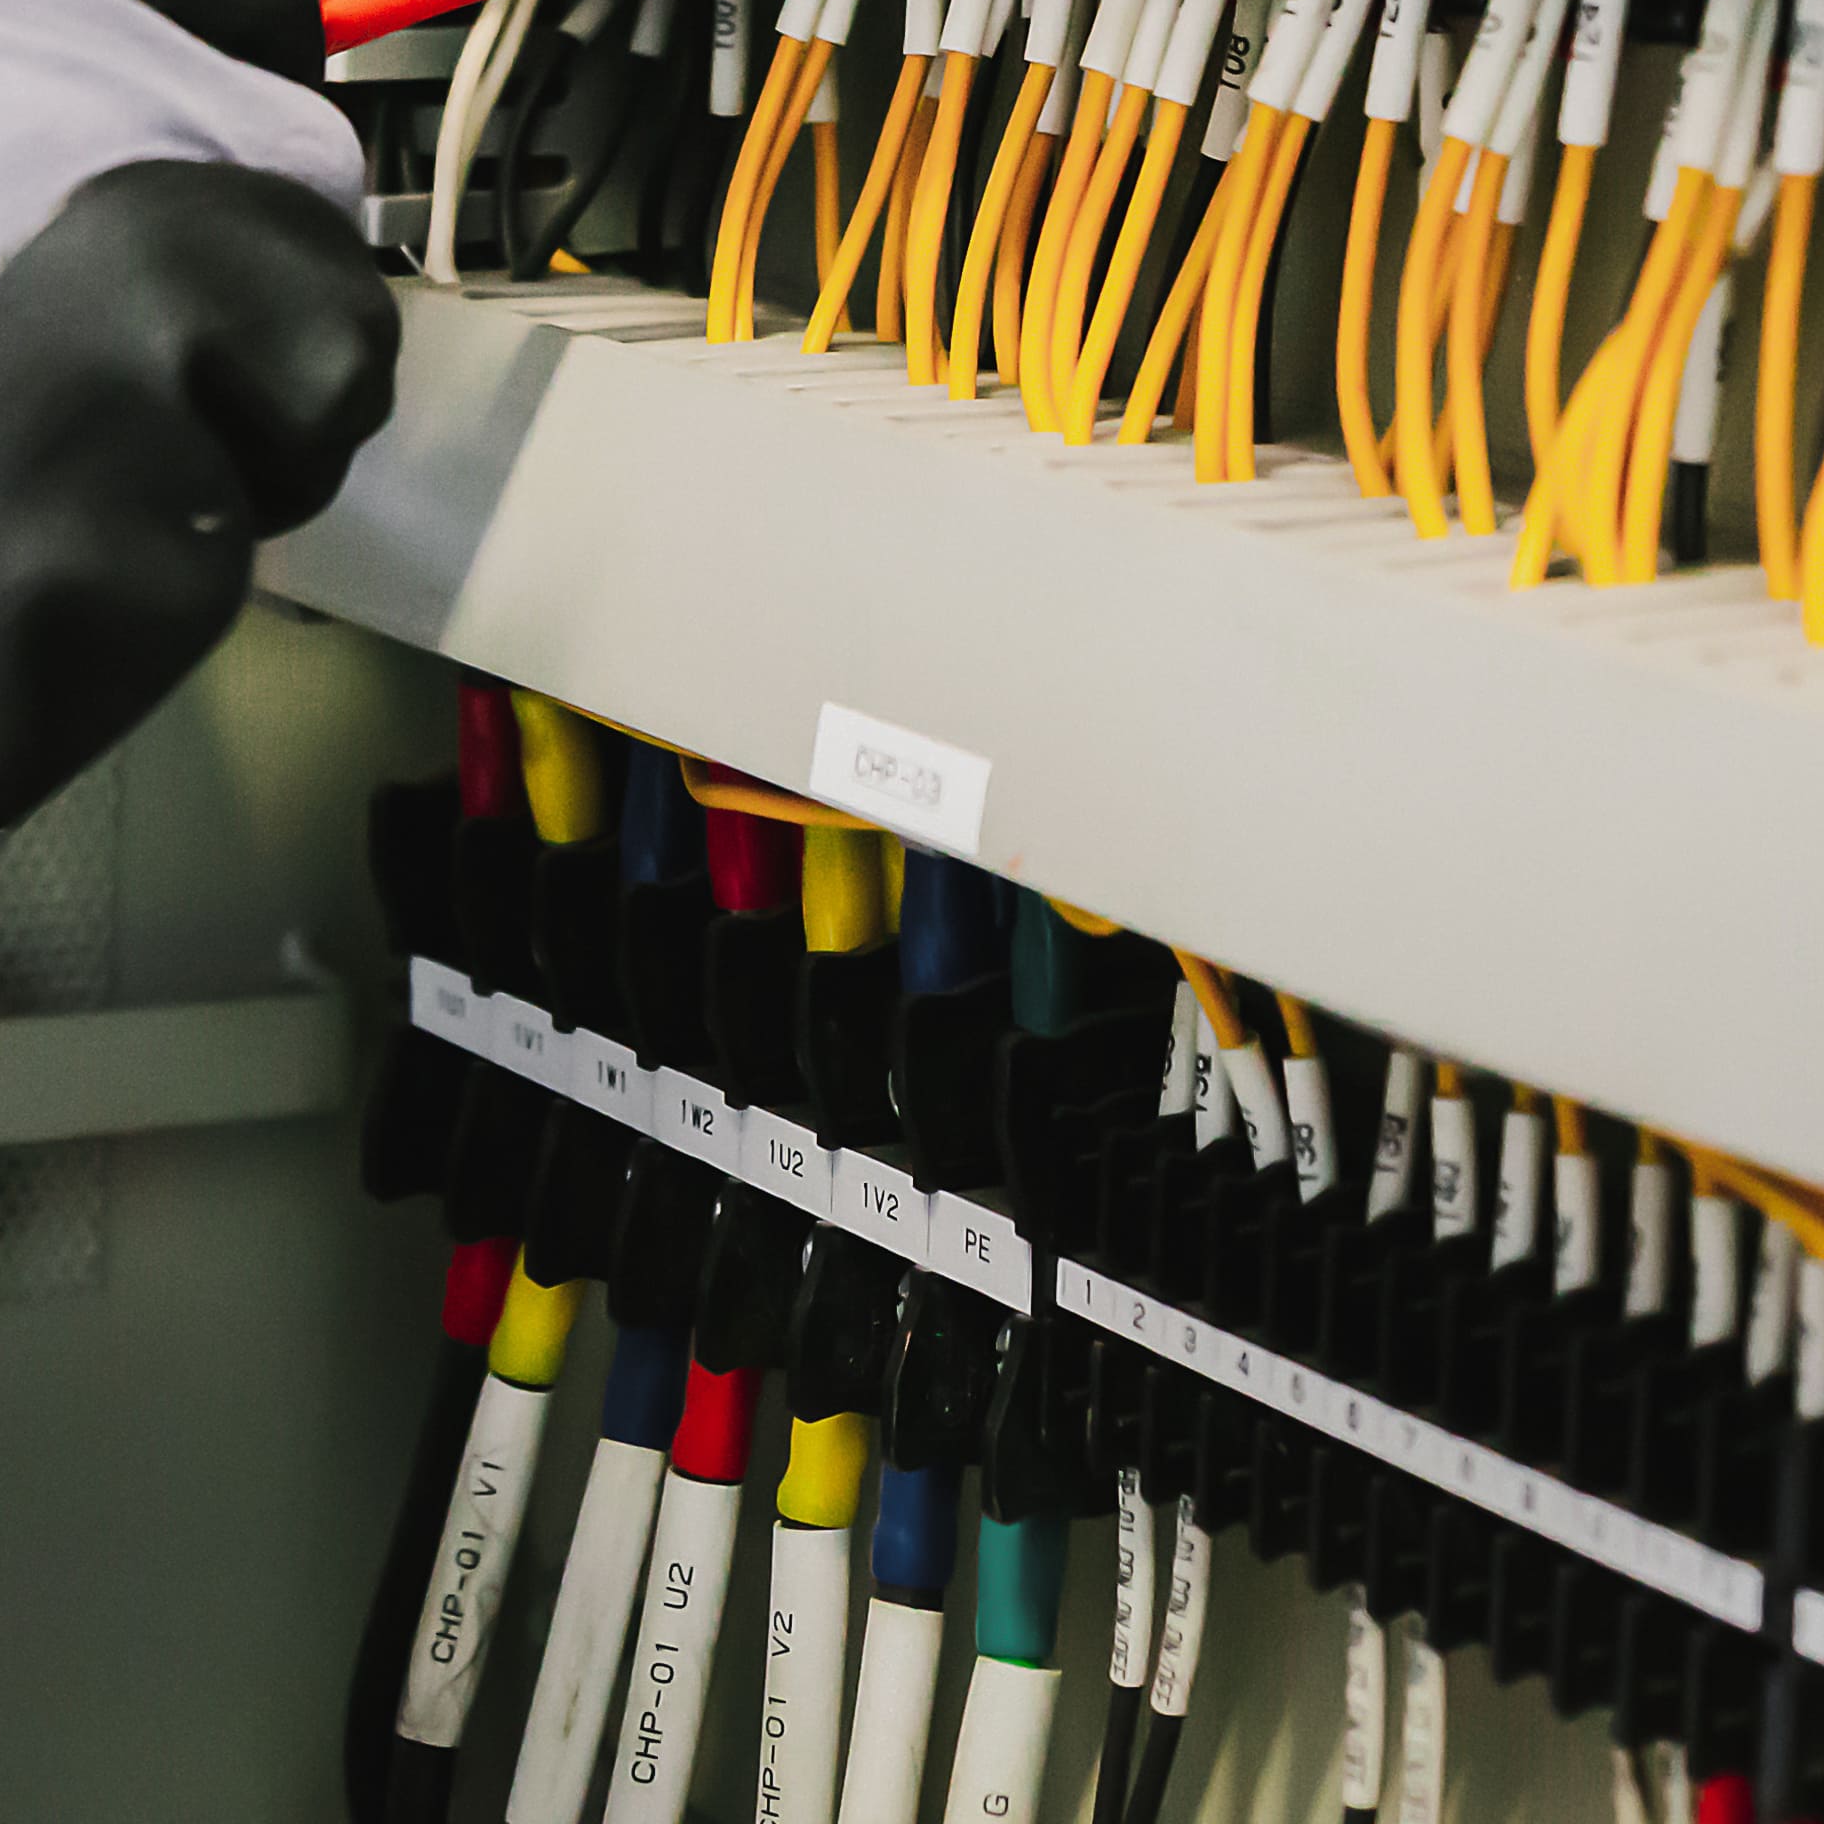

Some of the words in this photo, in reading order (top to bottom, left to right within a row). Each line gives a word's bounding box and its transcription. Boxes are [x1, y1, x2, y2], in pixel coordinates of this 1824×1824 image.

[598, 1060, 627, 1094] 1W1
[680, 1097, 715, 1136] 1W2
[769, 1138, 805, 1179] 1U2
[862, 1182, 901, 1222] 1V2
[964, 1227, 992, 1265] PE
[1133, 1302, 1146, 1332] 2
[431, 1529, 487, 1664] CHP-01
[475, 1461, 509, 1498] V1
[631, 1643, 680, 1784] CHP-01
[663, 1562, 695, 1610] U2
[771, 1610, 795, 1657] V2
[983, 1792, 1010, 1817] G
